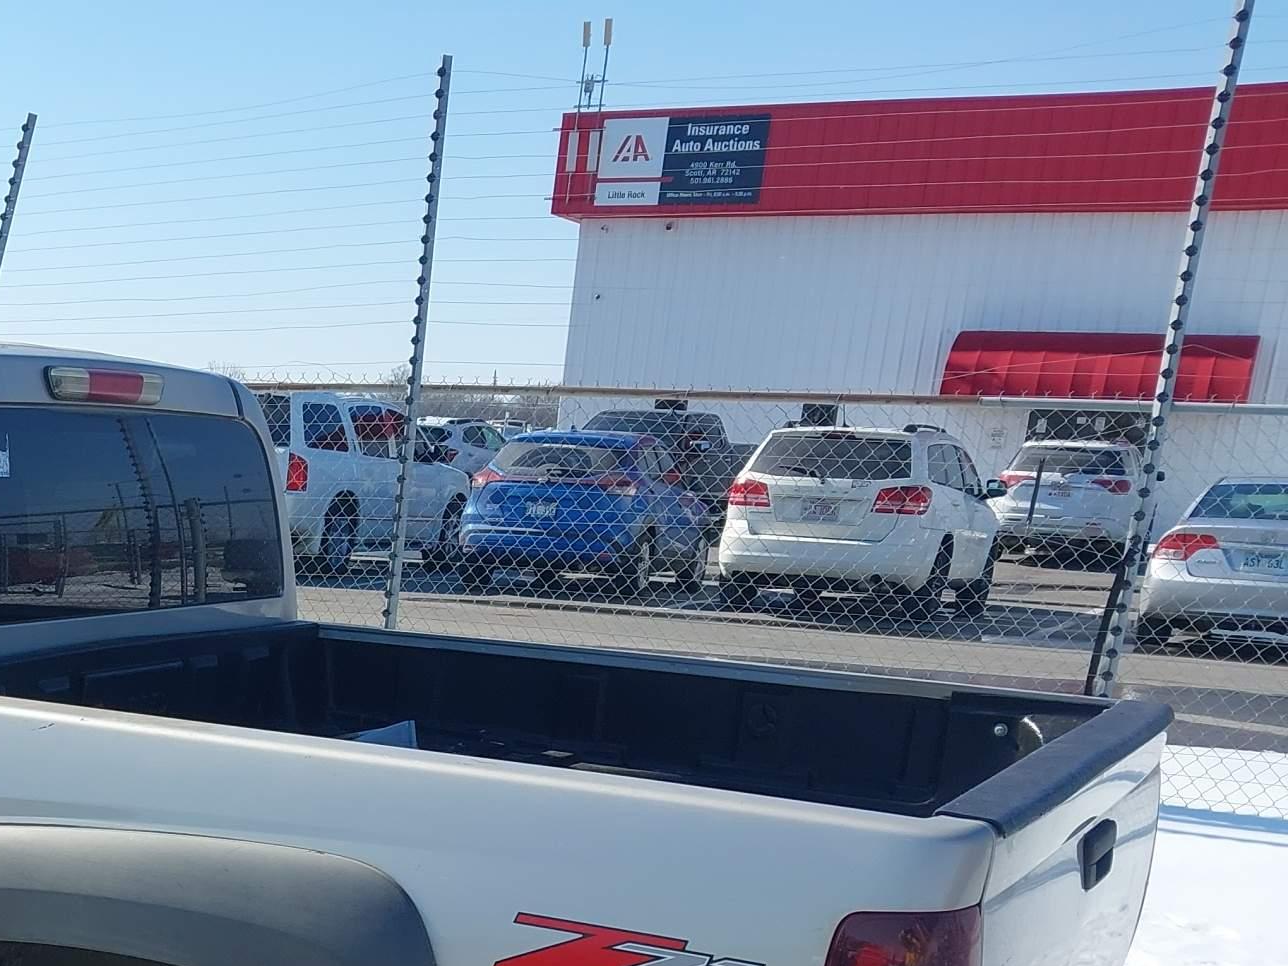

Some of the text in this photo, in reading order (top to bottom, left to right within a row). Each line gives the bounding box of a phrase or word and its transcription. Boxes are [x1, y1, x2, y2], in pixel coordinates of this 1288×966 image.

[687, 123, 750, 136] Insurance
[672, 138, 761, 152] Auto Auctions
[607, 190, 646, 199] Little Rock
